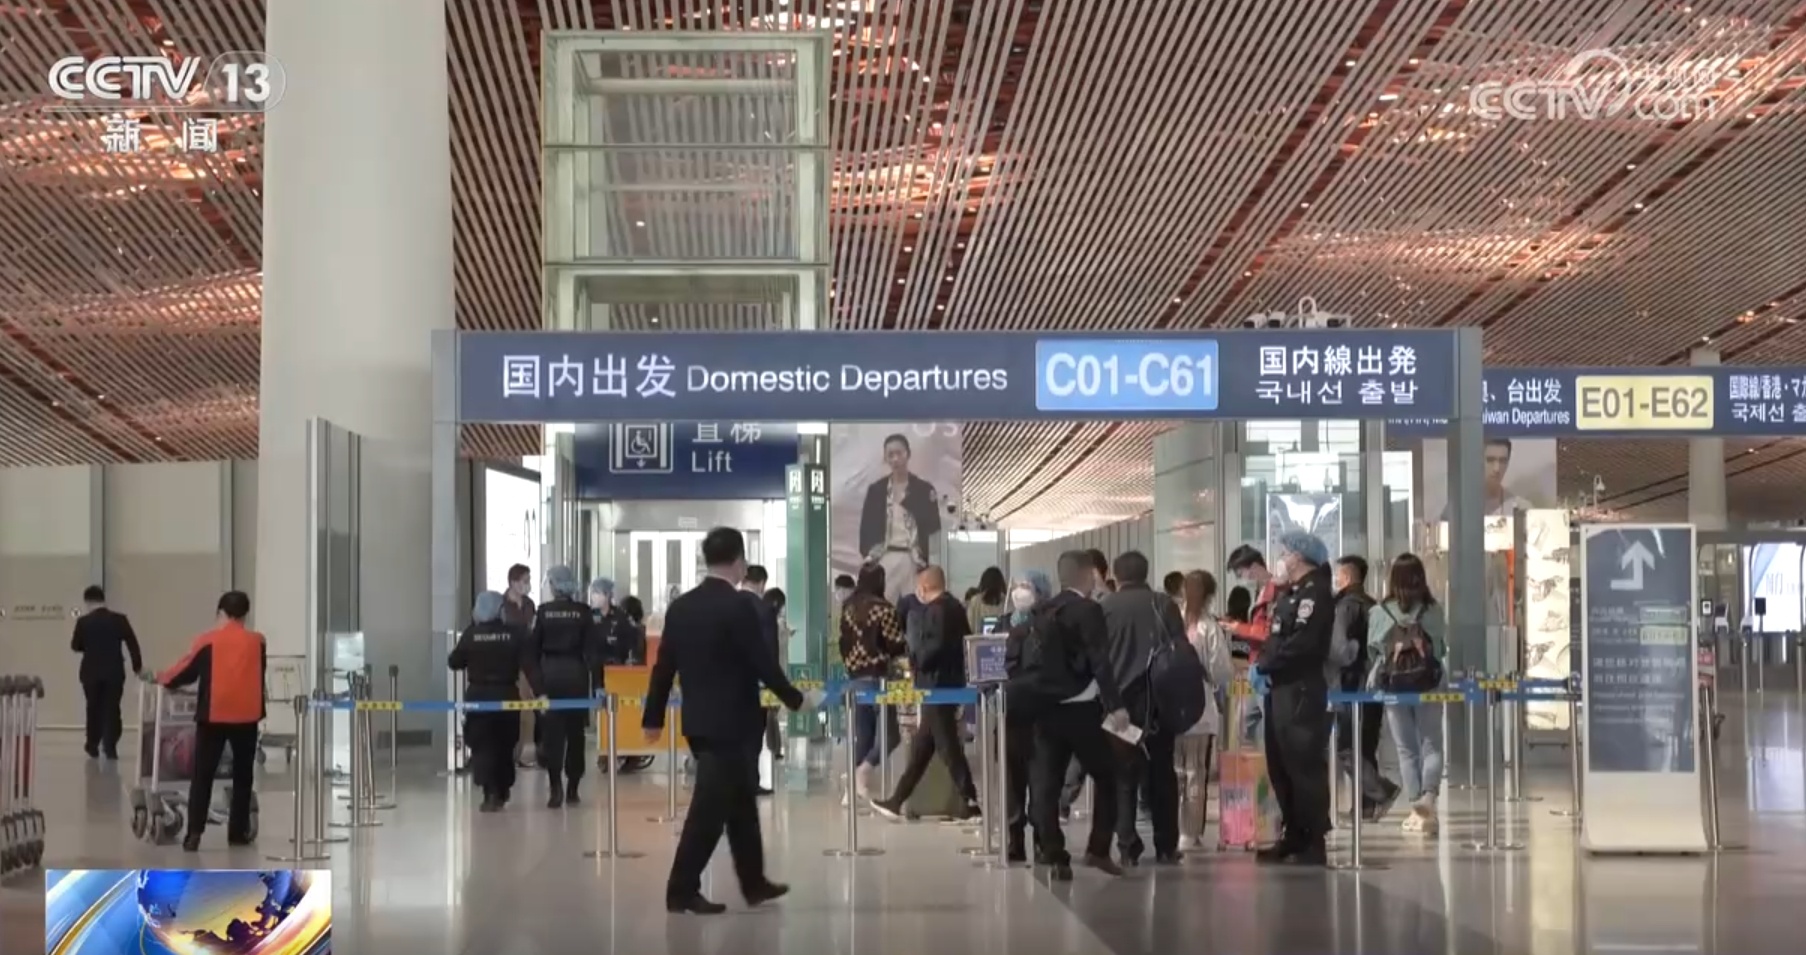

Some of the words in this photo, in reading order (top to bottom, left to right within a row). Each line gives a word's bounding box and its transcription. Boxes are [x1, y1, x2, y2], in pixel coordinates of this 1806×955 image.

[502, 353, 677, 399] 国内出发
[1045, 352, 1212, 397] C01-C61
[1259, 344, 1418, 376] 国内線出発
[687, 365, 831, 392] Domestic
[840, 364, 1008, 398] Departures
[1255, 379, 1343, 405] 국내선
[1358, 379, 1418, 405] 출발
[1511, 406, 1571, 428] Departures
[1581, 387, 1709, 419] E01-E62
[1731, 402, 1785, 423] 국제선
[691, 450, 732, 473] Lift
